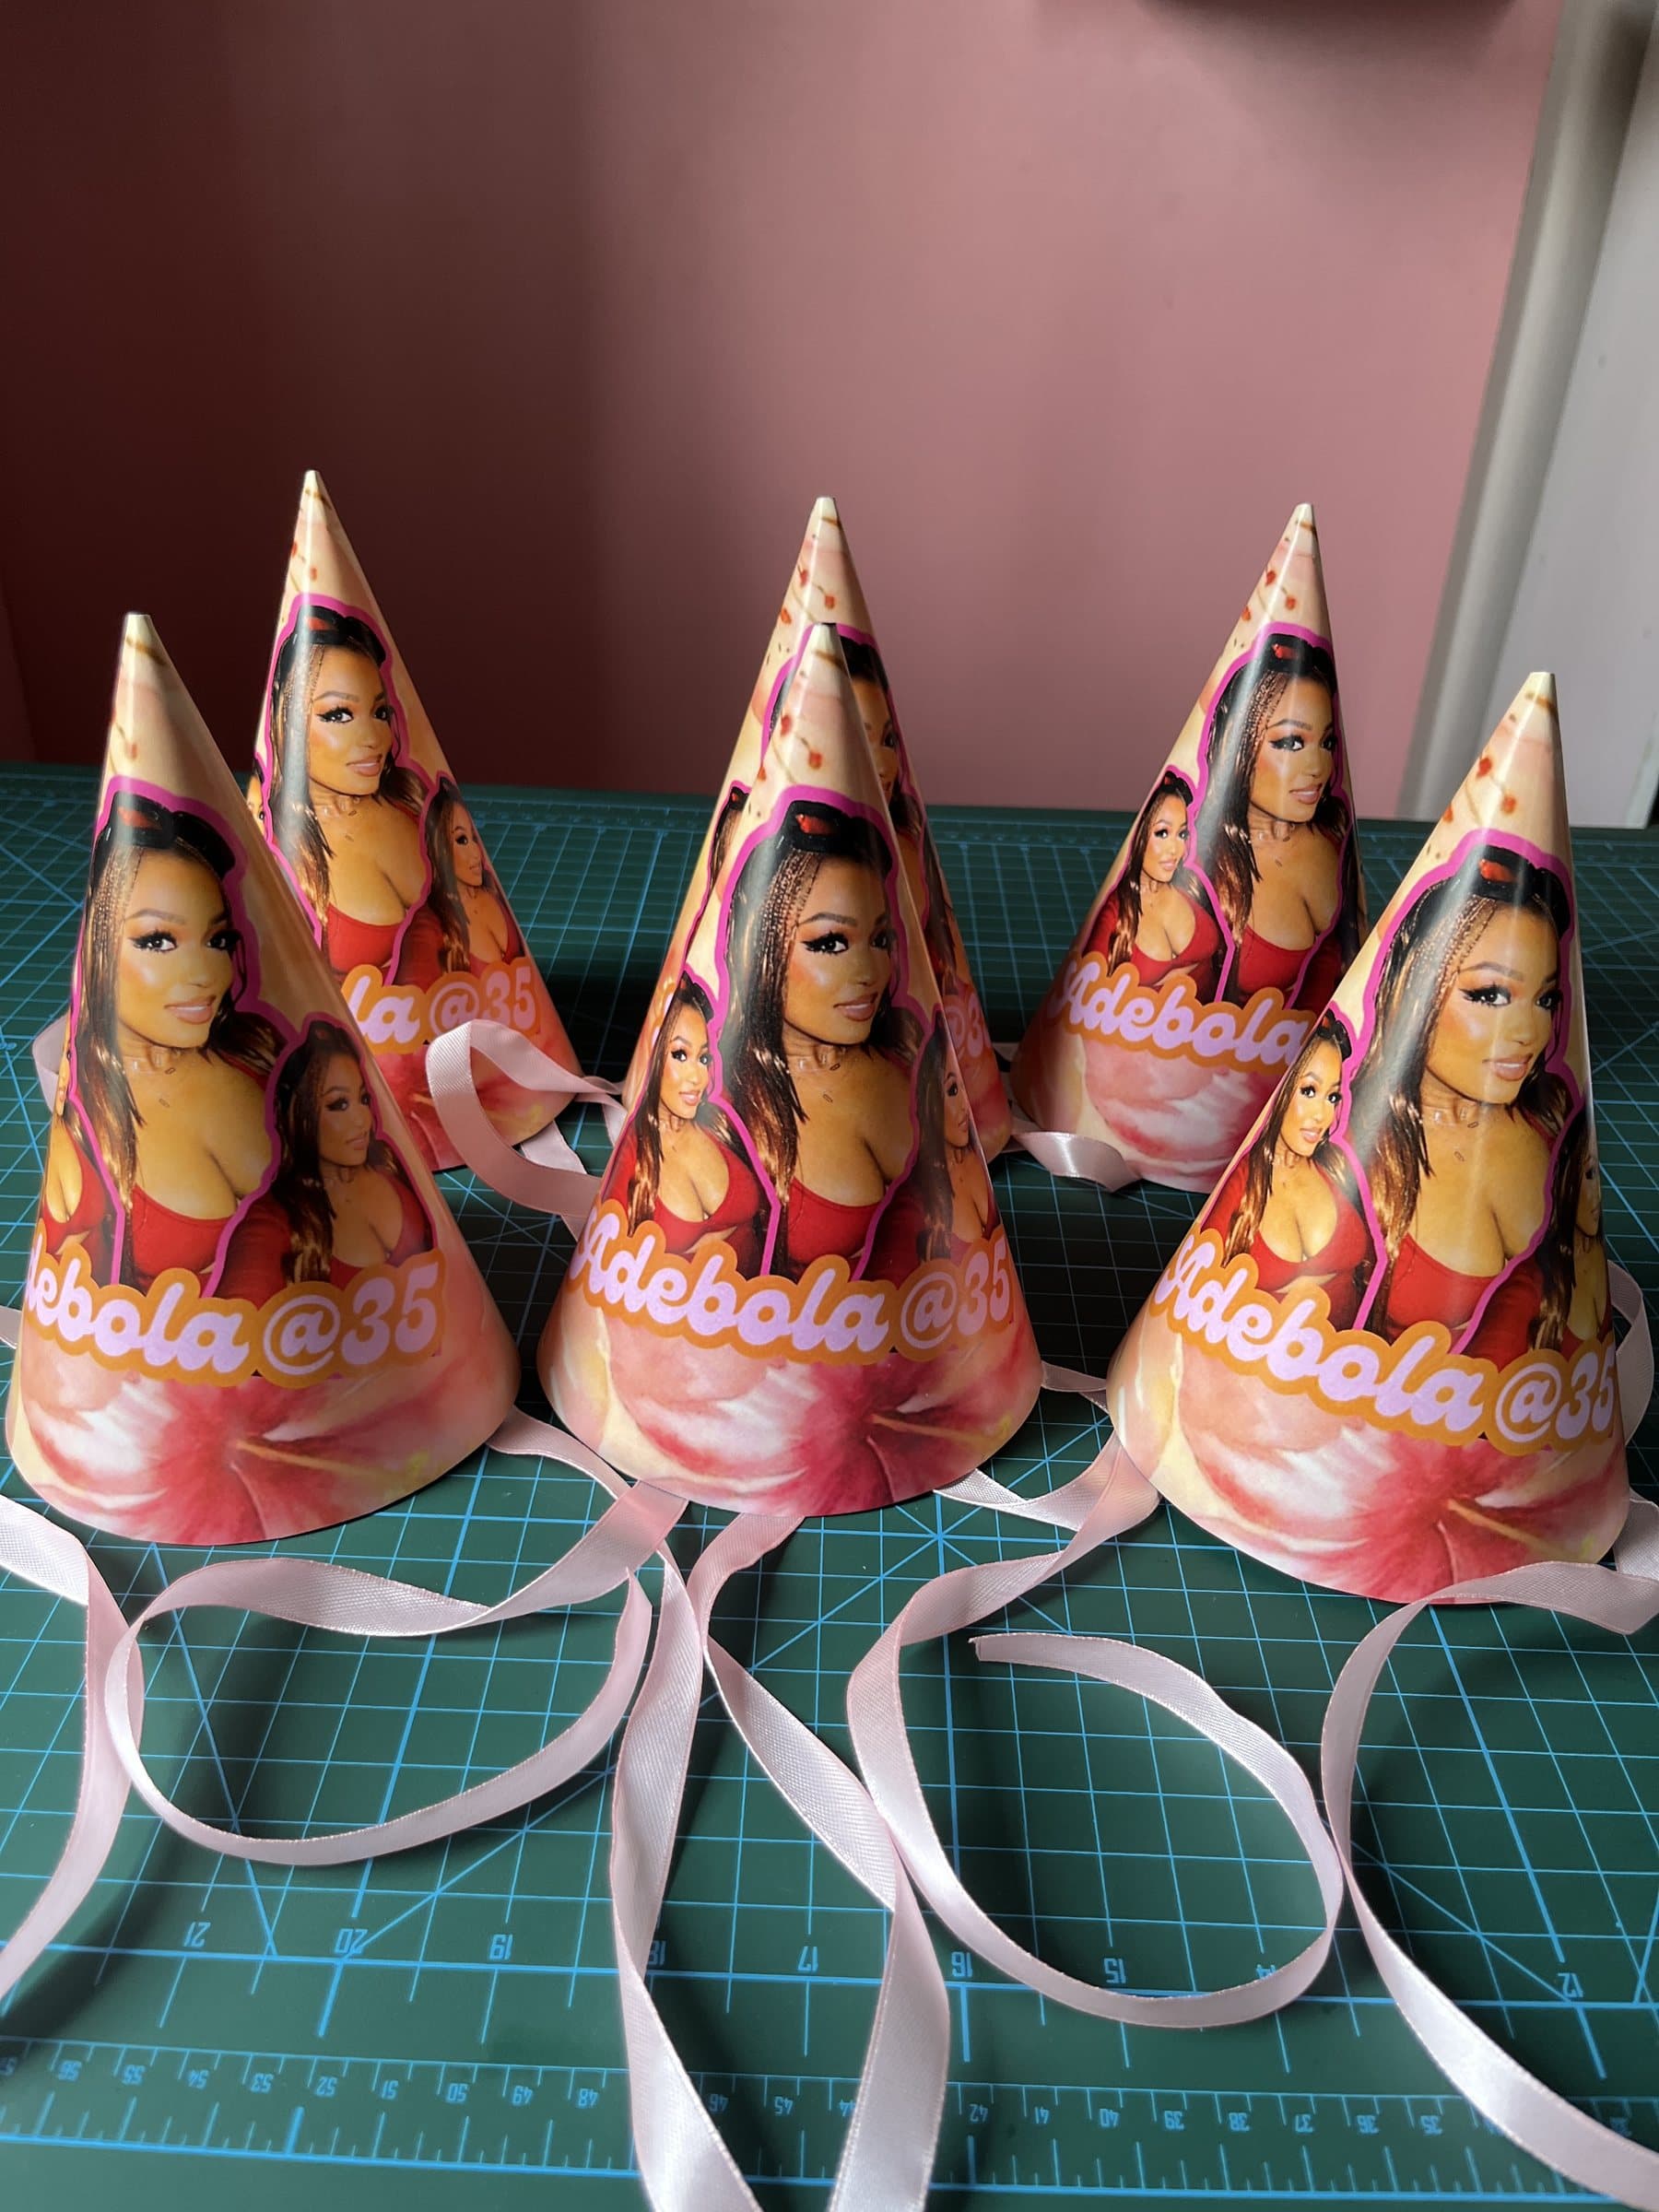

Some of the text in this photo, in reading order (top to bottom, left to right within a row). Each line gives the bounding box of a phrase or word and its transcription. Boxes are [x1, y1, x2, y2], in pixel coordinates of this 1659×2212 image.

[570, 1206, 889, 1353] Adebola
[1154, 1235, 1485, 1432] Adebola
[184, 1922, 211, 1947] 21
[334, 1927, 368, 1955] 20
[488, 1934, 514, 1960] 19
[796, 1946, 818, 1972] 17
[951, 1951, 972, 1978] 16
[1103, 1958, 1126, 1984] 15
[1557, 1972, 1583, 1998] 12
[314, 2076, 338, 2099] 52
[381, 2079, 399, 2100] 51
[445, 2082, 469, 2104] 50
[512, 2085, 534, 2107] 49
[577, 2088, 599, 2109] 48
